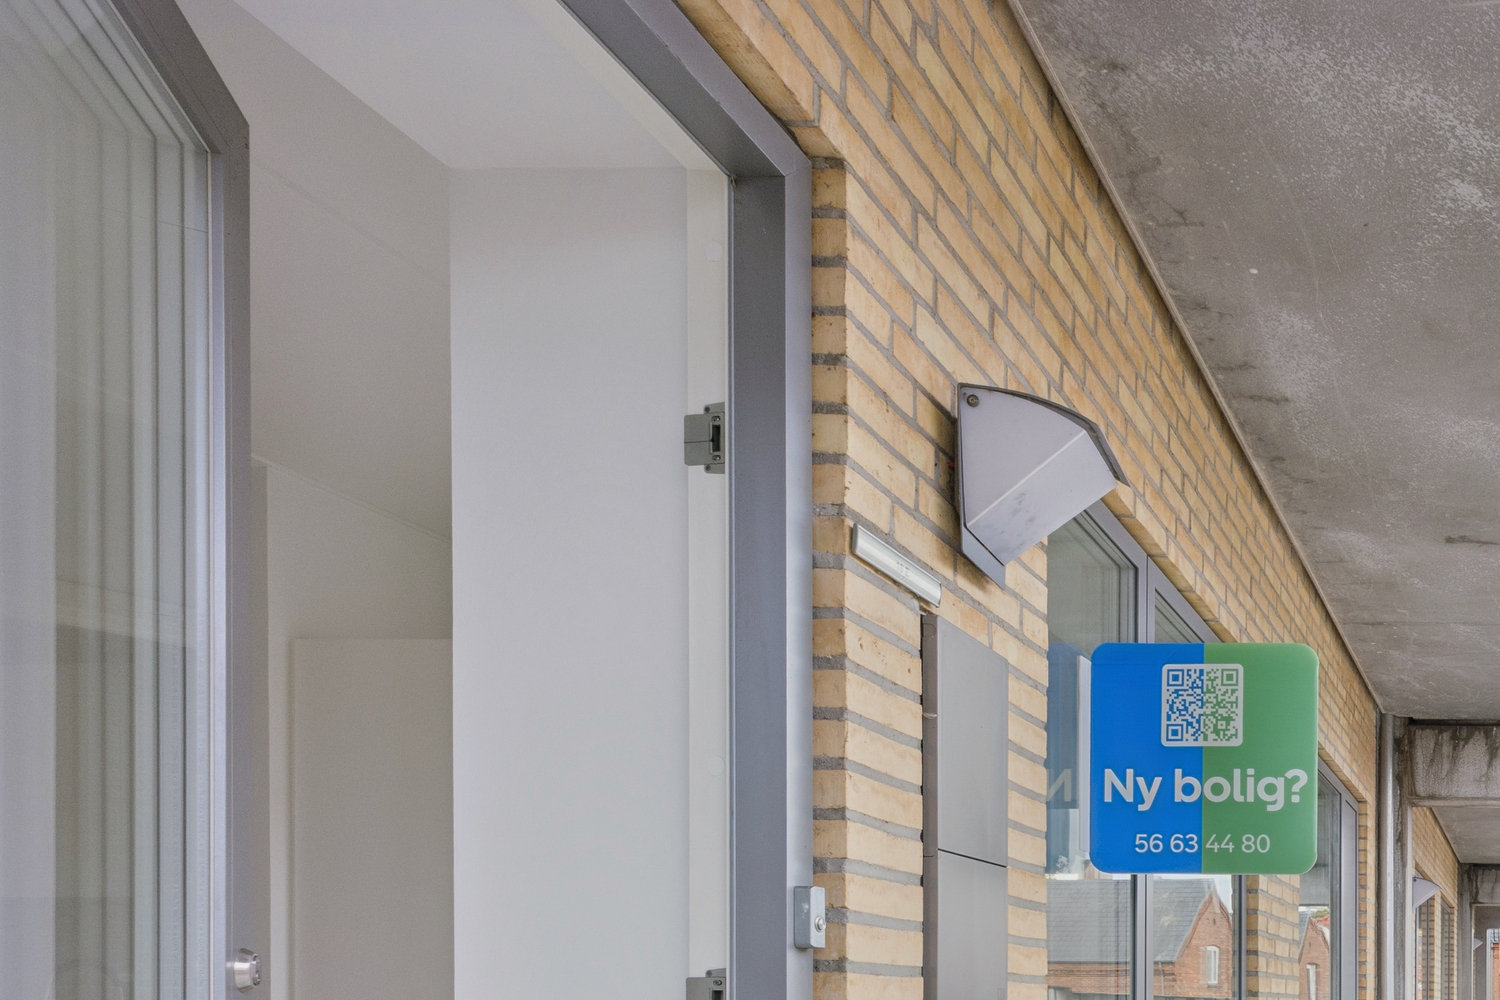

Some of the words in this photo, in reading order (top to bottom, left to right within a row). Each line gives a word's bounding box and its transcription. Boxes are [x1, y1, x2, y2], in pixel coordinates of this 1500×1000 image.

[1103, 768, 1162, 812] Ny
[1174, 768, 1308, 812] bolig?
[1134, 833, 1163, 853] 56
[1169, 833, 1198, 853] 63
[1205, 833, 1235, 853] 44
[1241, 833, 1271, 853] 80
